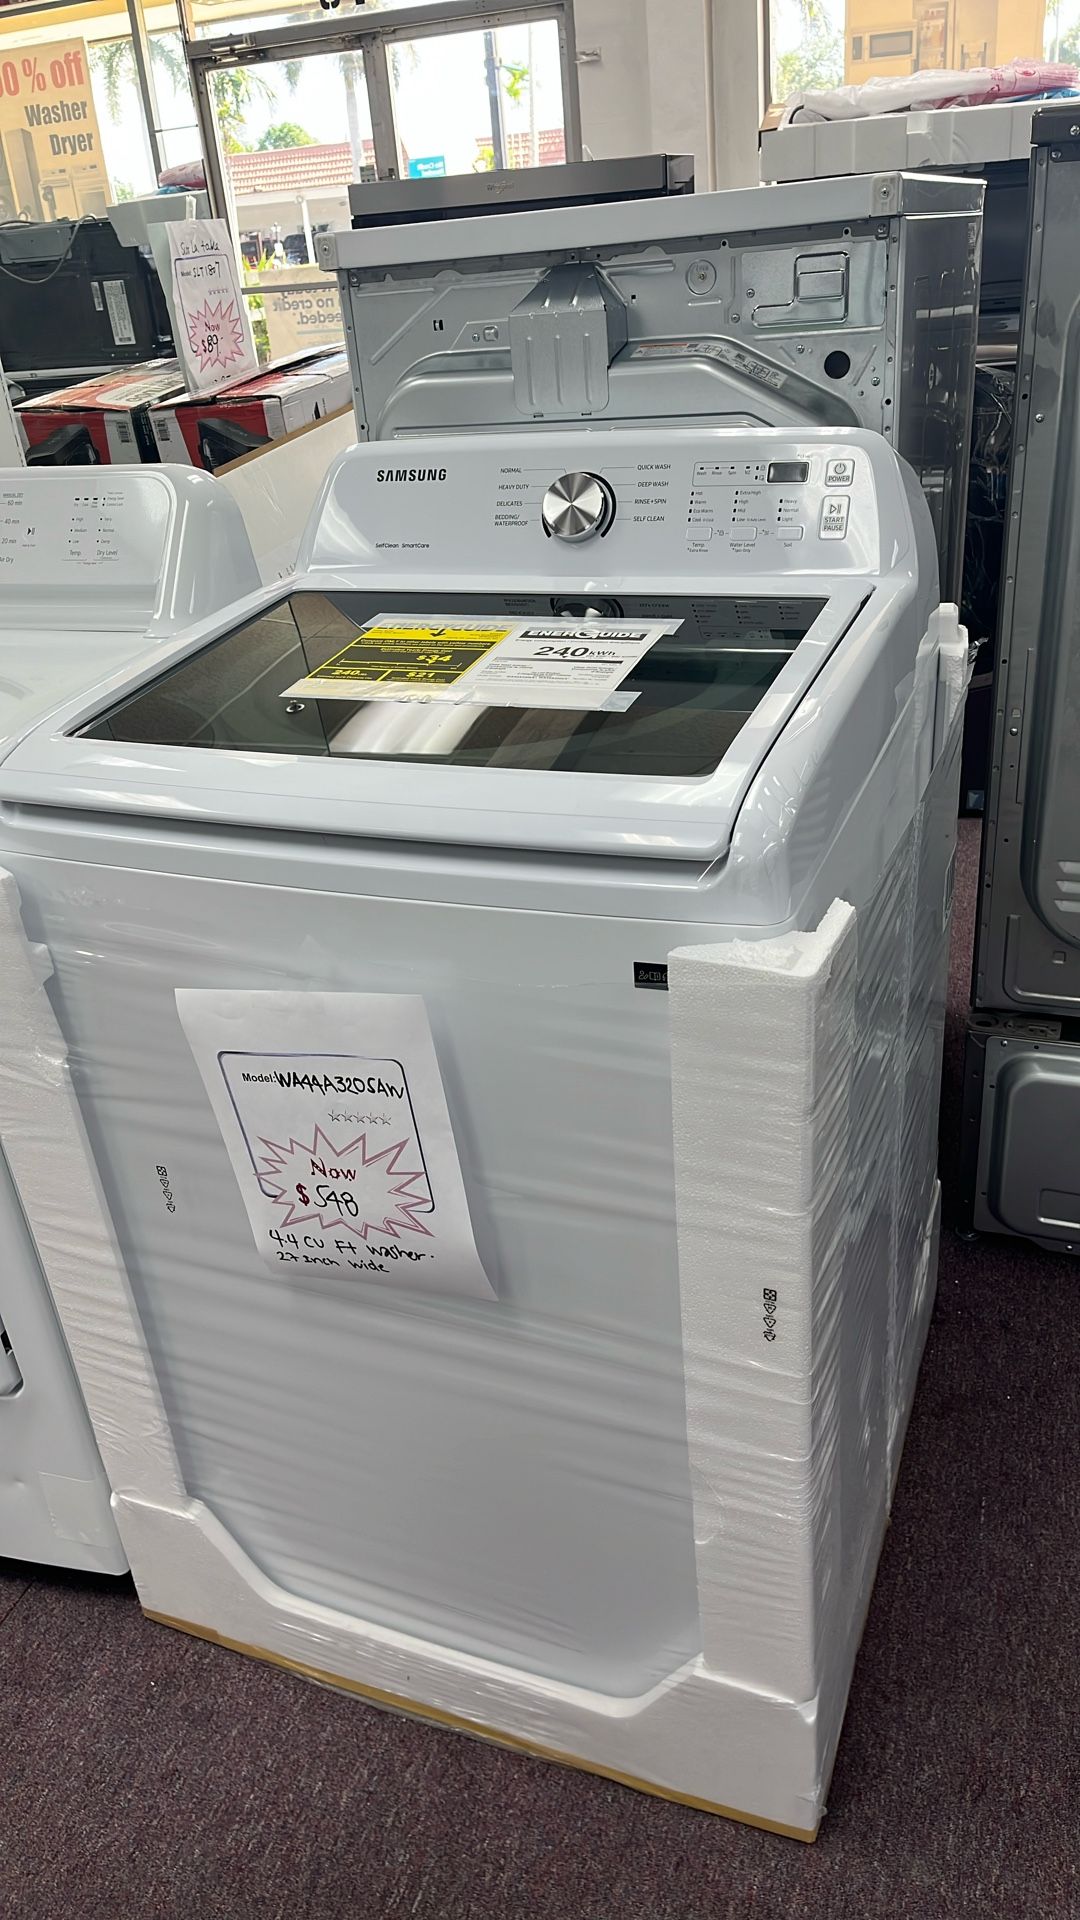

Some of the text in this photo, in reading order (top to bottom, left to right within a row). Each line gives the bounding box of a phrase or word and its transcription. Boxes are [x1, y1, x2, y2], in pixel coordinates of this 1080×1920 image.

[50, 51, 84, 89] off
[24, 101, 88, 127] Washer
[49, 132, 94, 156] Dryer
[204, 321, 221, 332] Now
[376, 468, 447, 482] SAMSUNG
[5, 556, 14, 565] Dry
[416, 655, 453, 663] $34
[533, 646, 590, 657] 240
[241, 1072, 277, 1083] Model:
[310, 1157, 357, 1182] Now
[269, 1229, 299, 1249] 4.4
[334, 1239, 358, 1255] Ft
[276, 1251, 300, 1262] 27
[347, 1259, 391, 1273] wide
